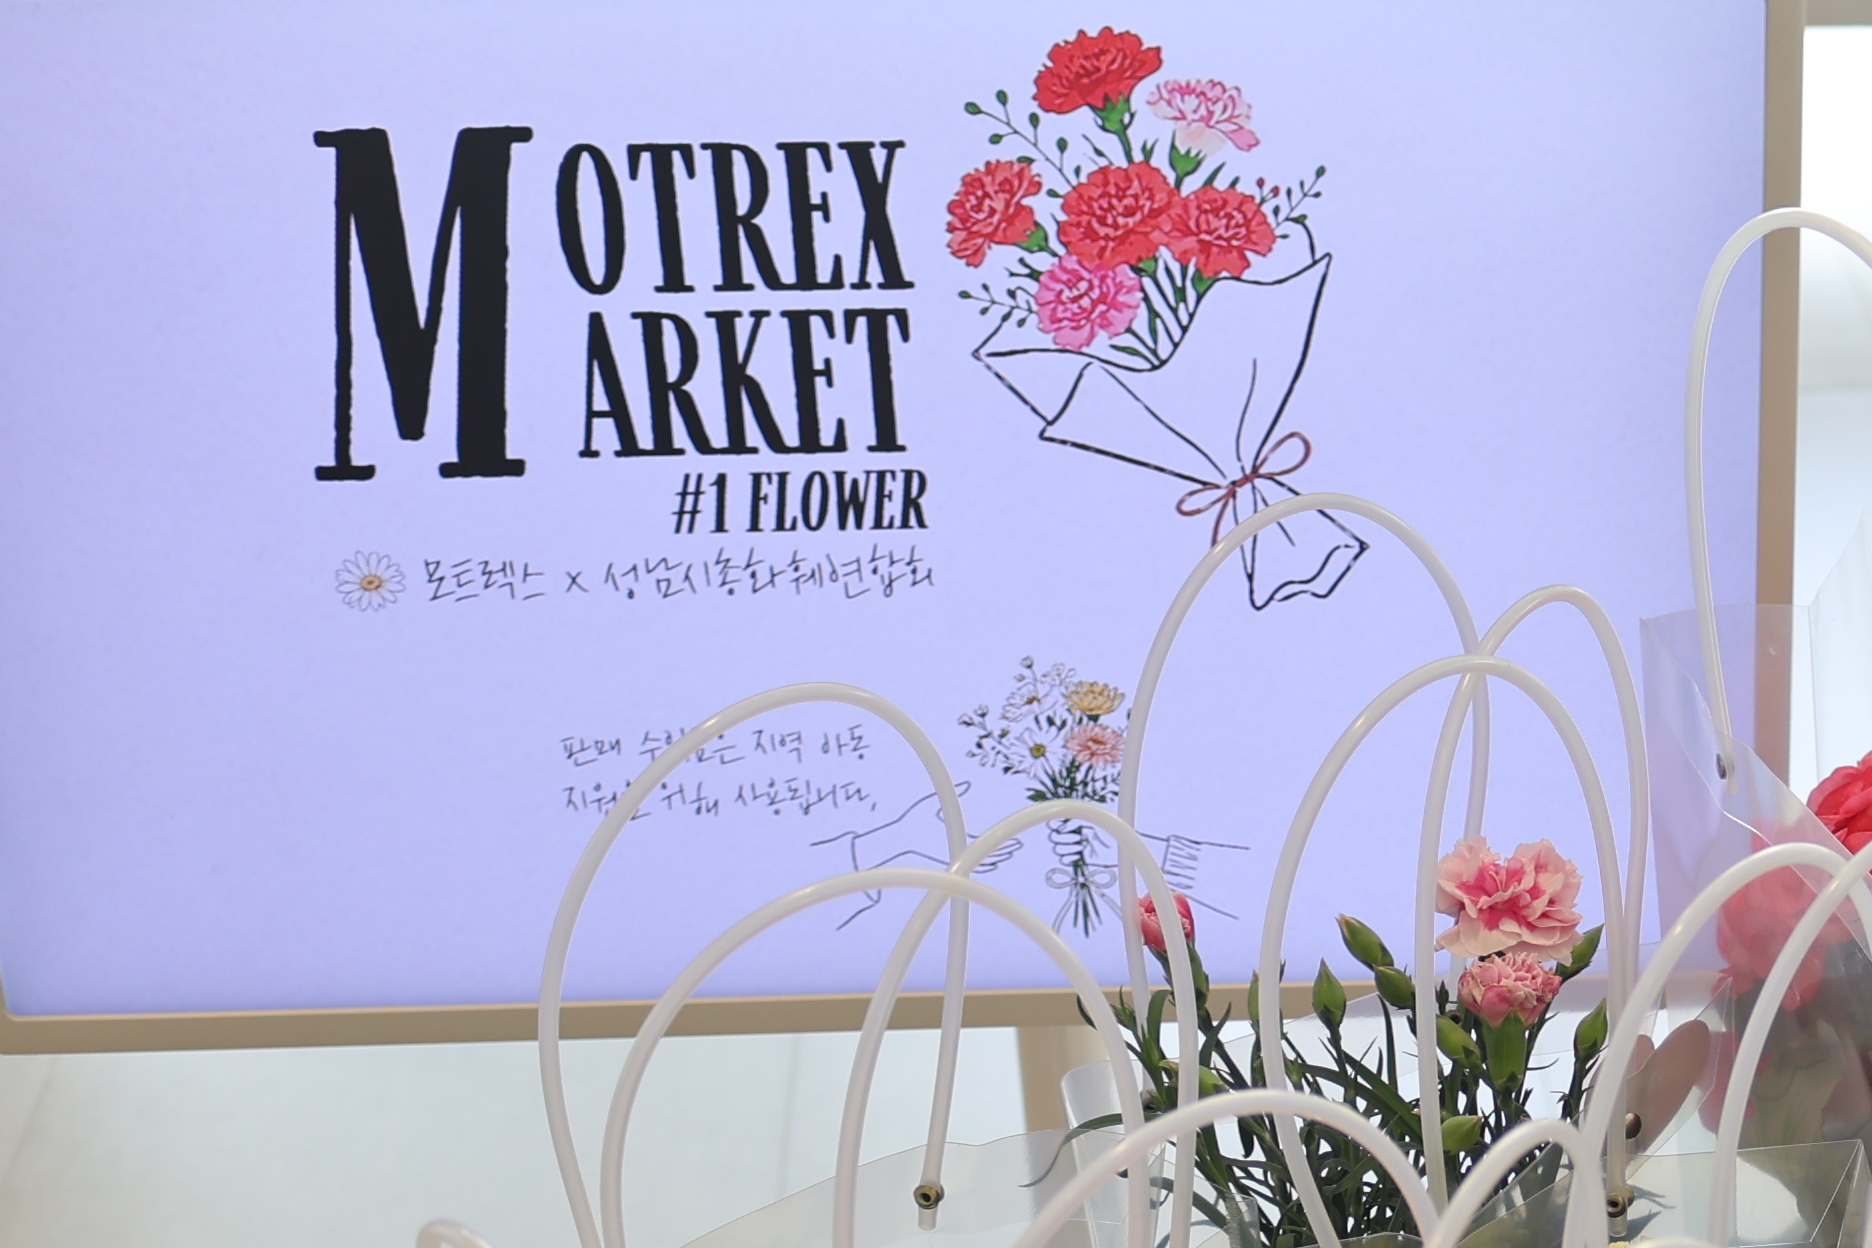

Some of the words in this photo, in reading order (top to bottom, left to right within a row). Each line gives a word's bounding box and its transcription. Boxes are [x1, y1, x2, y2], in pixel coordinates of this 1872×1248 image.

[671, 472, 729, 534] #1
[747, 469, 930, 534] FLOWER
[424, 557, 545, 602] 모트렉스
[560, 736, 622, 767] 판매
[752, 730, 802, 763] 지역
[822, 724, 871, 760] 아동
[659, 781, 720, 816] 위해
